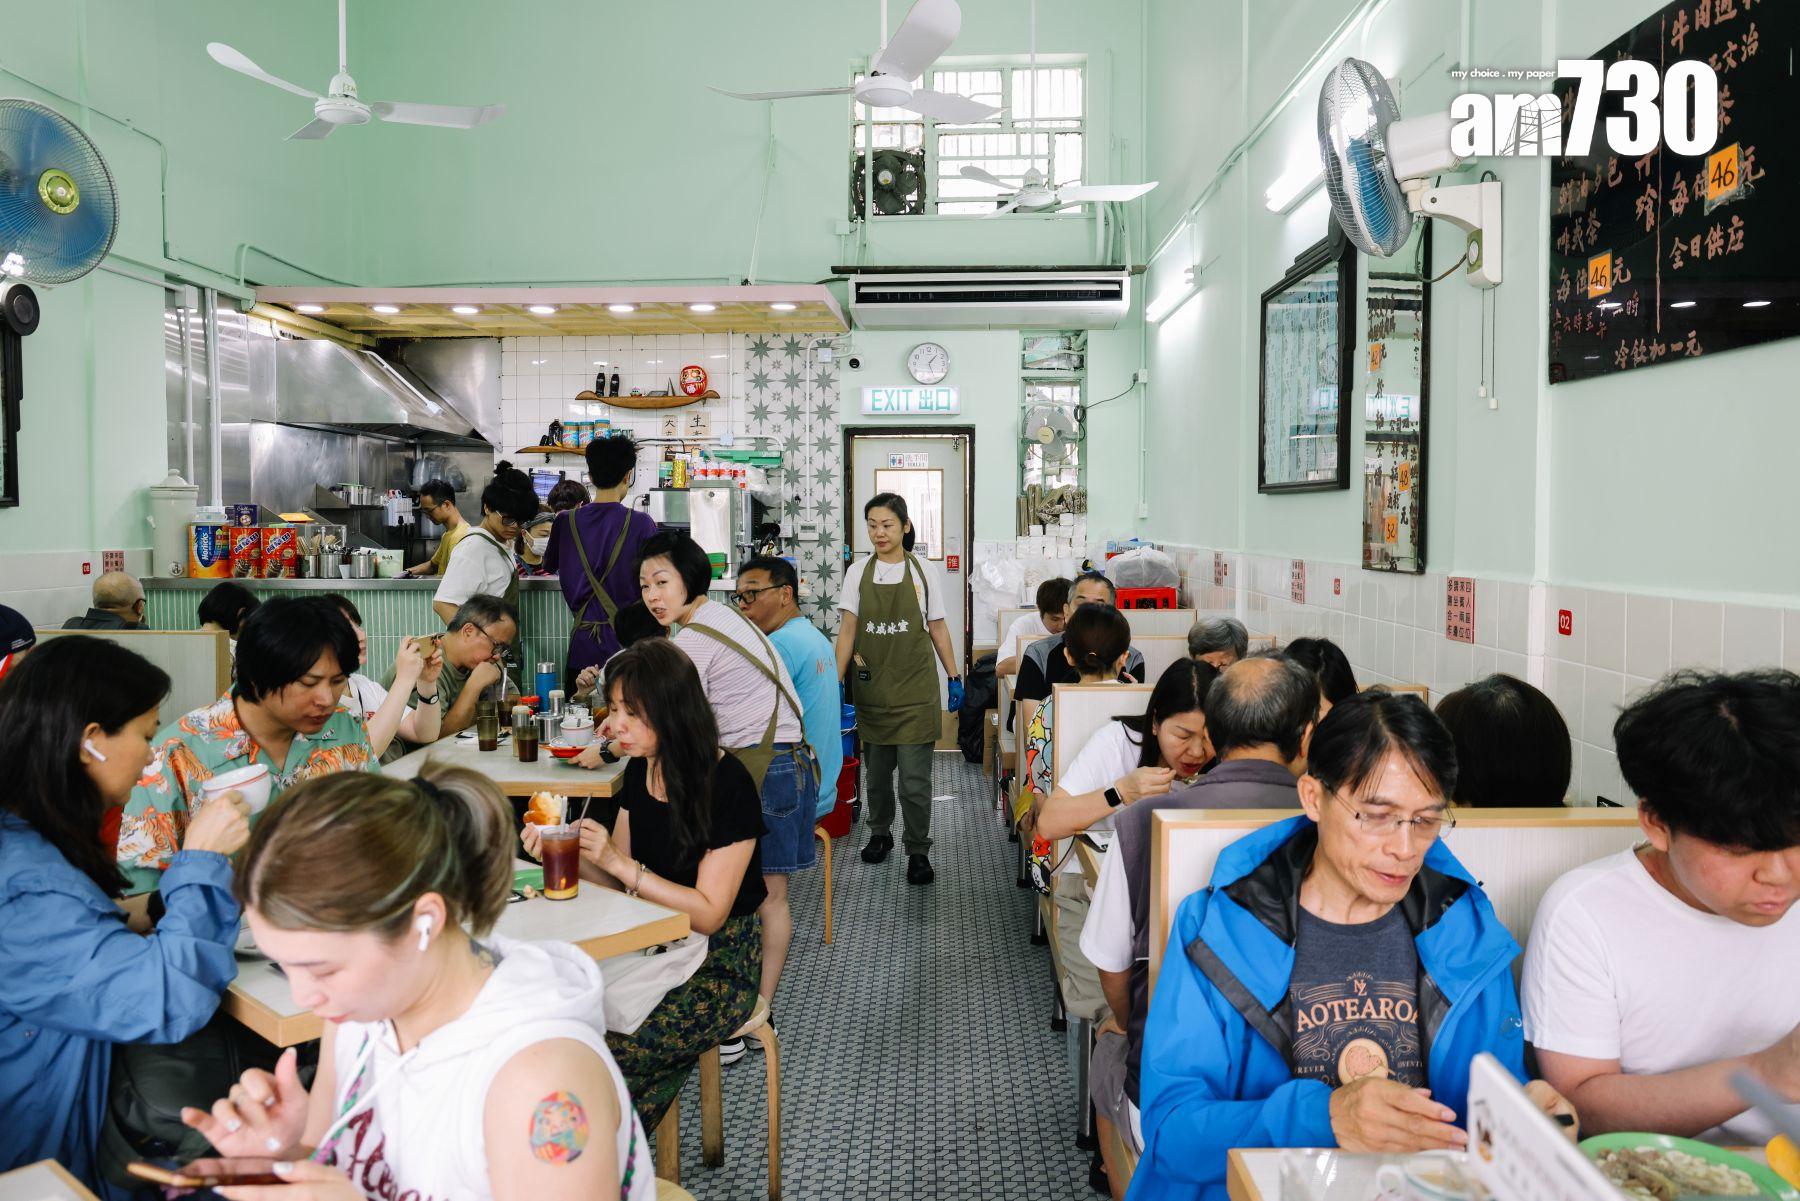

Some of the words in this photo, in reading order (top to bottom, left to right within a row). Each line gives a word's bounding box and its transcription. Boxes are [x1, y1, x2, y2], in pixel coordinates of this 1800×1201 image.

[871, 389, 913, 411] EXIT
[918, 388, 951, 411] 出口
[201, 532, 209, 561] Horlicks
[1560, 615, 1570, 630] 02
